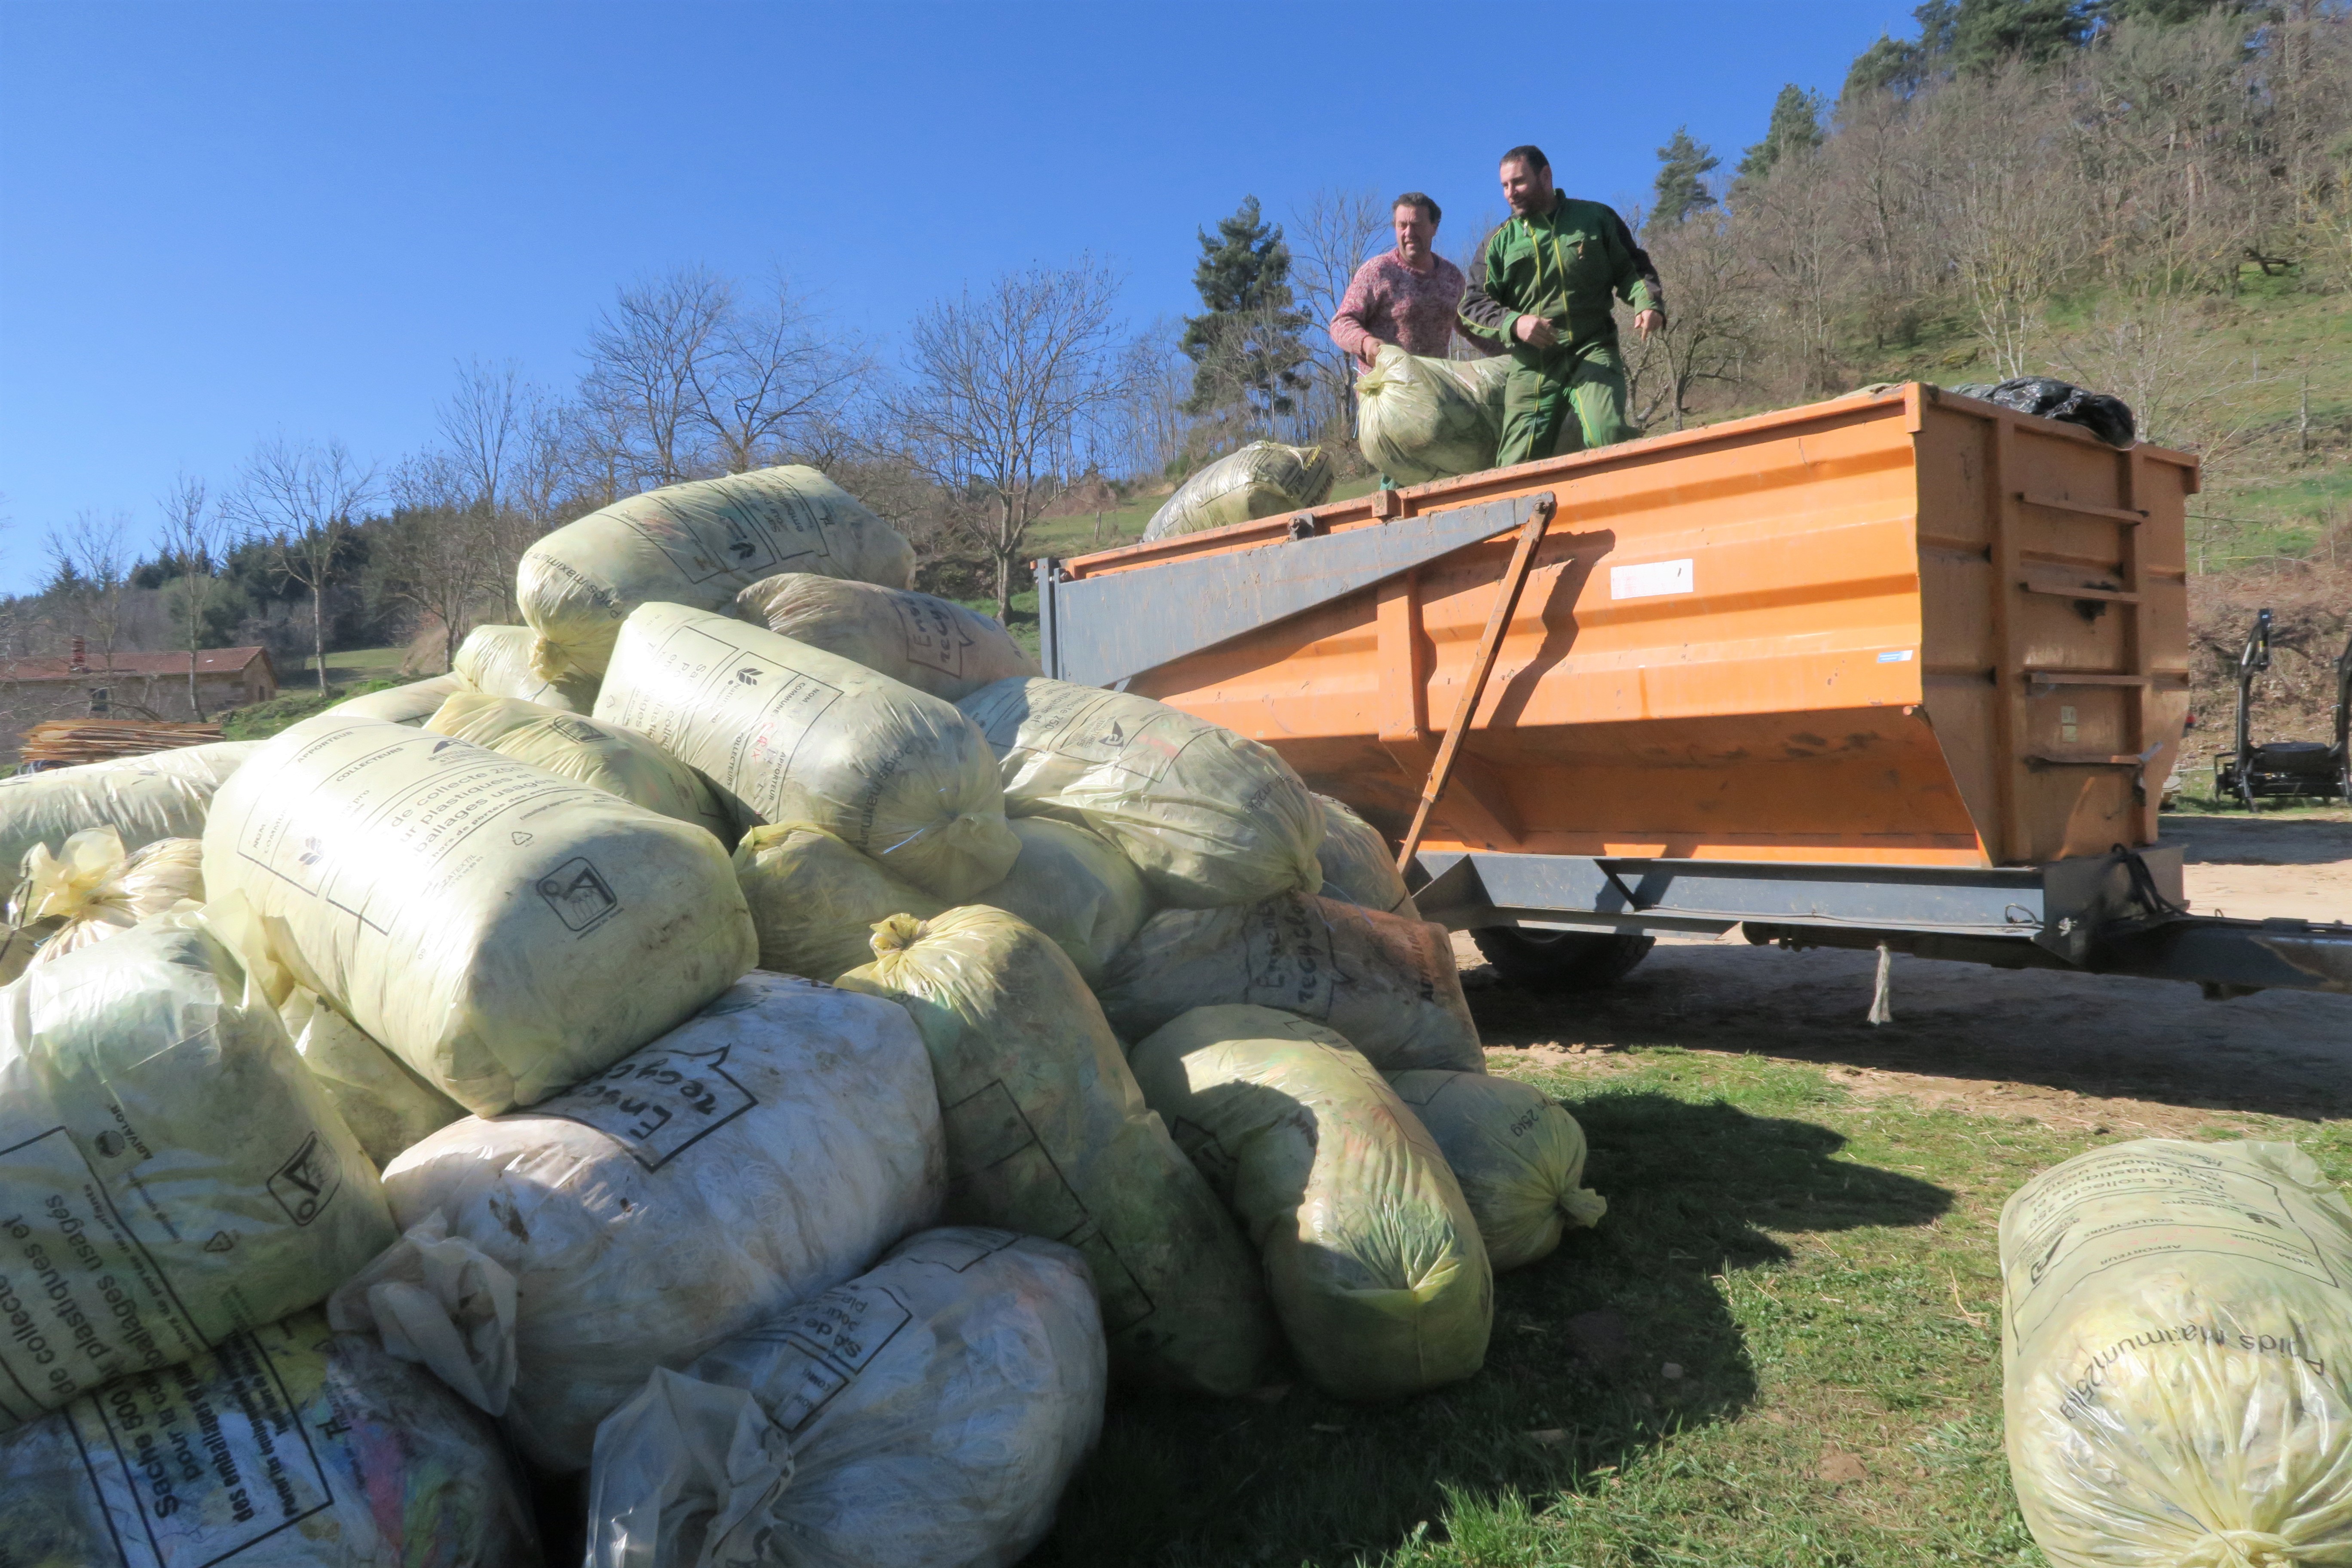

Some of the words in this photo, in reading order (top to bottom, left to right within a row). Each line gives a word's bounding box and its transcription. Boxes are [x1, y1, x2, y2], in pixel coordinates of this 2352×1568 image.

[531, 552, 589, 585] maximum
[773, 682, 805, 714] COMMUNE
[802, 688, 820, 703] NOM
[1044, 714, 1064, 731] 250
[297, 731, 354, 763] APPORTEUR
[336, 747, 404, 782] COLLECTEURS
[769, 751, 786, 801] APPORTEUR
[391, 809, 414, 828] de
[416, 771, 488, 806] collecte
[490, 766, 524, 776] 250
[399, 824, 418, 844] ur
[420, 775, 514, 825] plastiques
[413, 797, 490, 853] ballages
[491, 776, 557, 798] usagés
[431, 833, 454, 858] hors
[110, 1103, 153, 1161] ADIVALOR
[2052, 1168, 2160, 1195] plastiques
[2061, 1178, 2145, 1201] collecte
[6, 1212, 30, 1241] et
[44, 1194, 103, 1271] usagés
[2029, 1204, 2055, 1229] 250
[2083, 1218, 2175, 1238] COLLECTEURS
[2100, 1244, 2182, 1265] APPORTEUR
[2232, 1233, 2310, 1258] COMMUNE
[2278, 1253, 2316, 1268] NOM
[22, 1242, 110, 1359] plastiques
[110, 1390, 144, 1432] 500
[158, 1406, 176, 1429] la
[166, 1428, 204, 1482] pour
[196, 1403, 240, 1488] emballages
[137, 1435, 178, 1518] Sache
[228, 1488, 254, 1524] des
